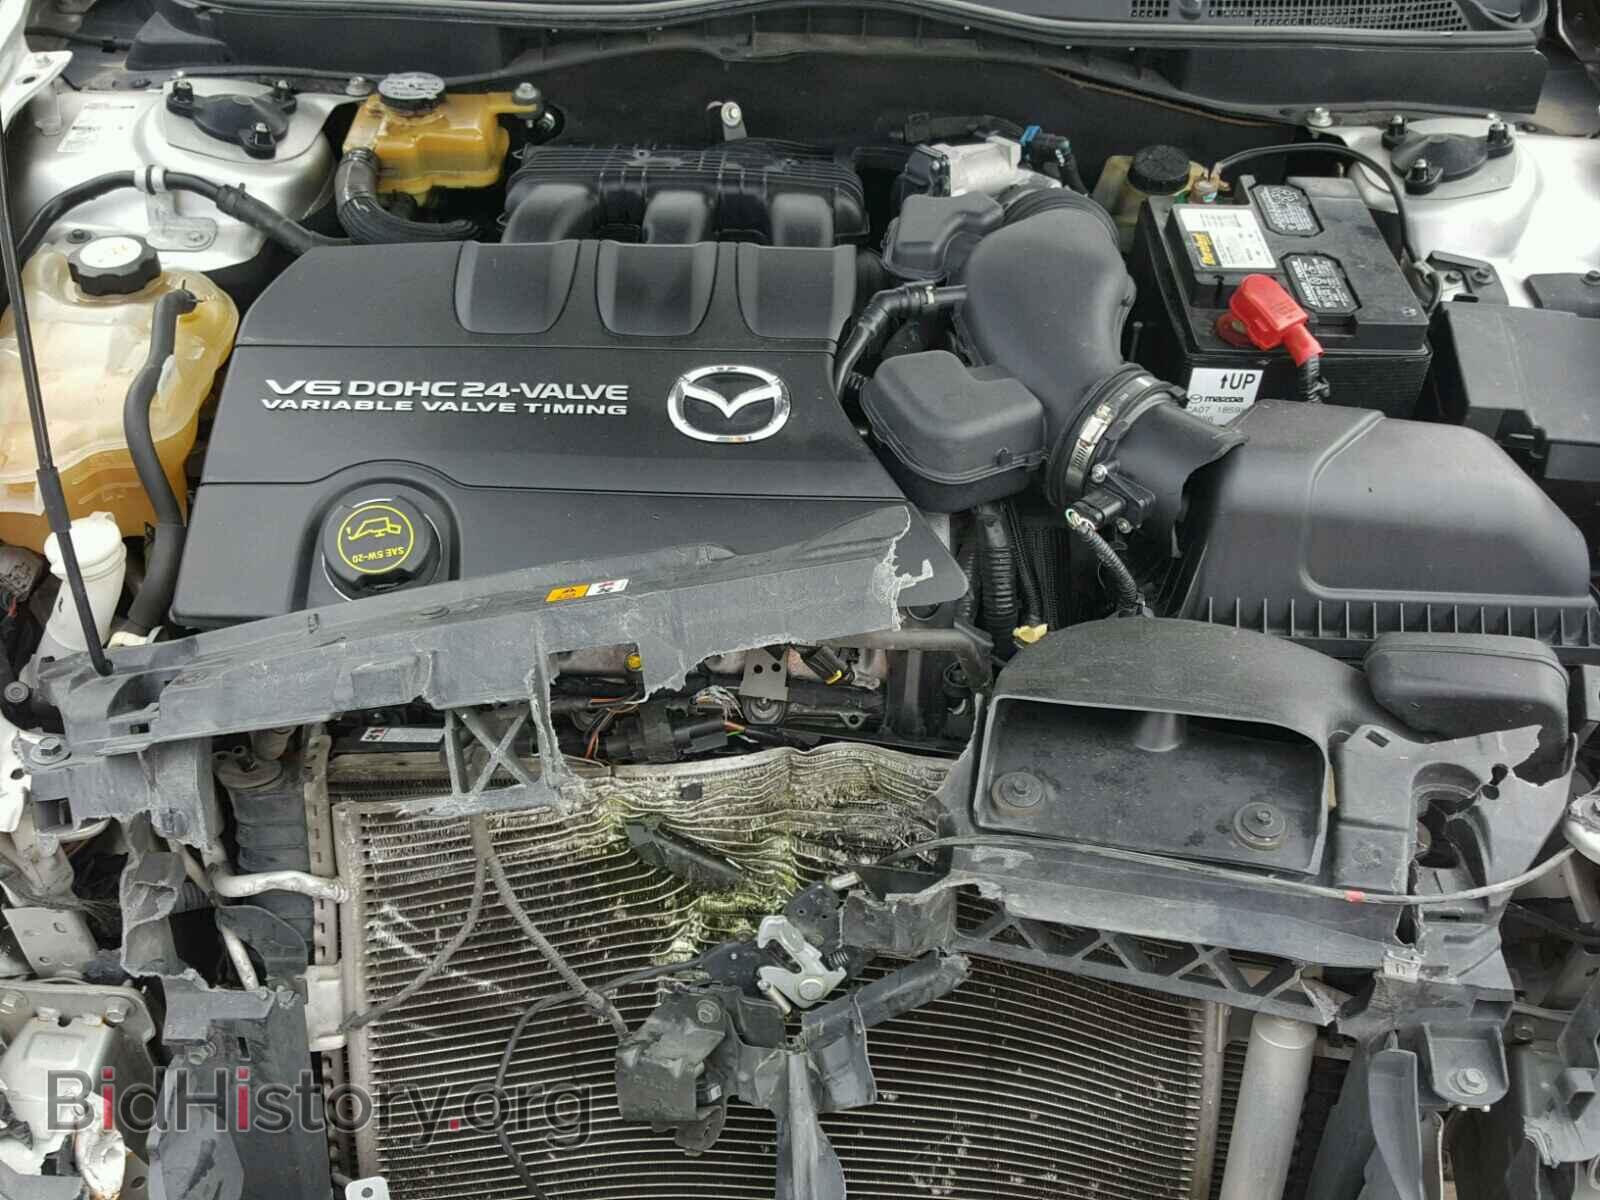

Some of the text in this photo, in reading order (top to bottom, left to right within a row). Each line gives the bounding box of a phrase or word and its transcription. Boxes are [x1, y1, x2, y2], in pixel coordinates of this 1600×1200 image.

[264, 379, 629, 401] V6 DOHC 24-VALVE
[1229, 373, 1256, 390] UP
[261, 399, 628, 415] VARIABLE VALVE TIMING
[352, 546, 405, 564] SAE 5W-20
